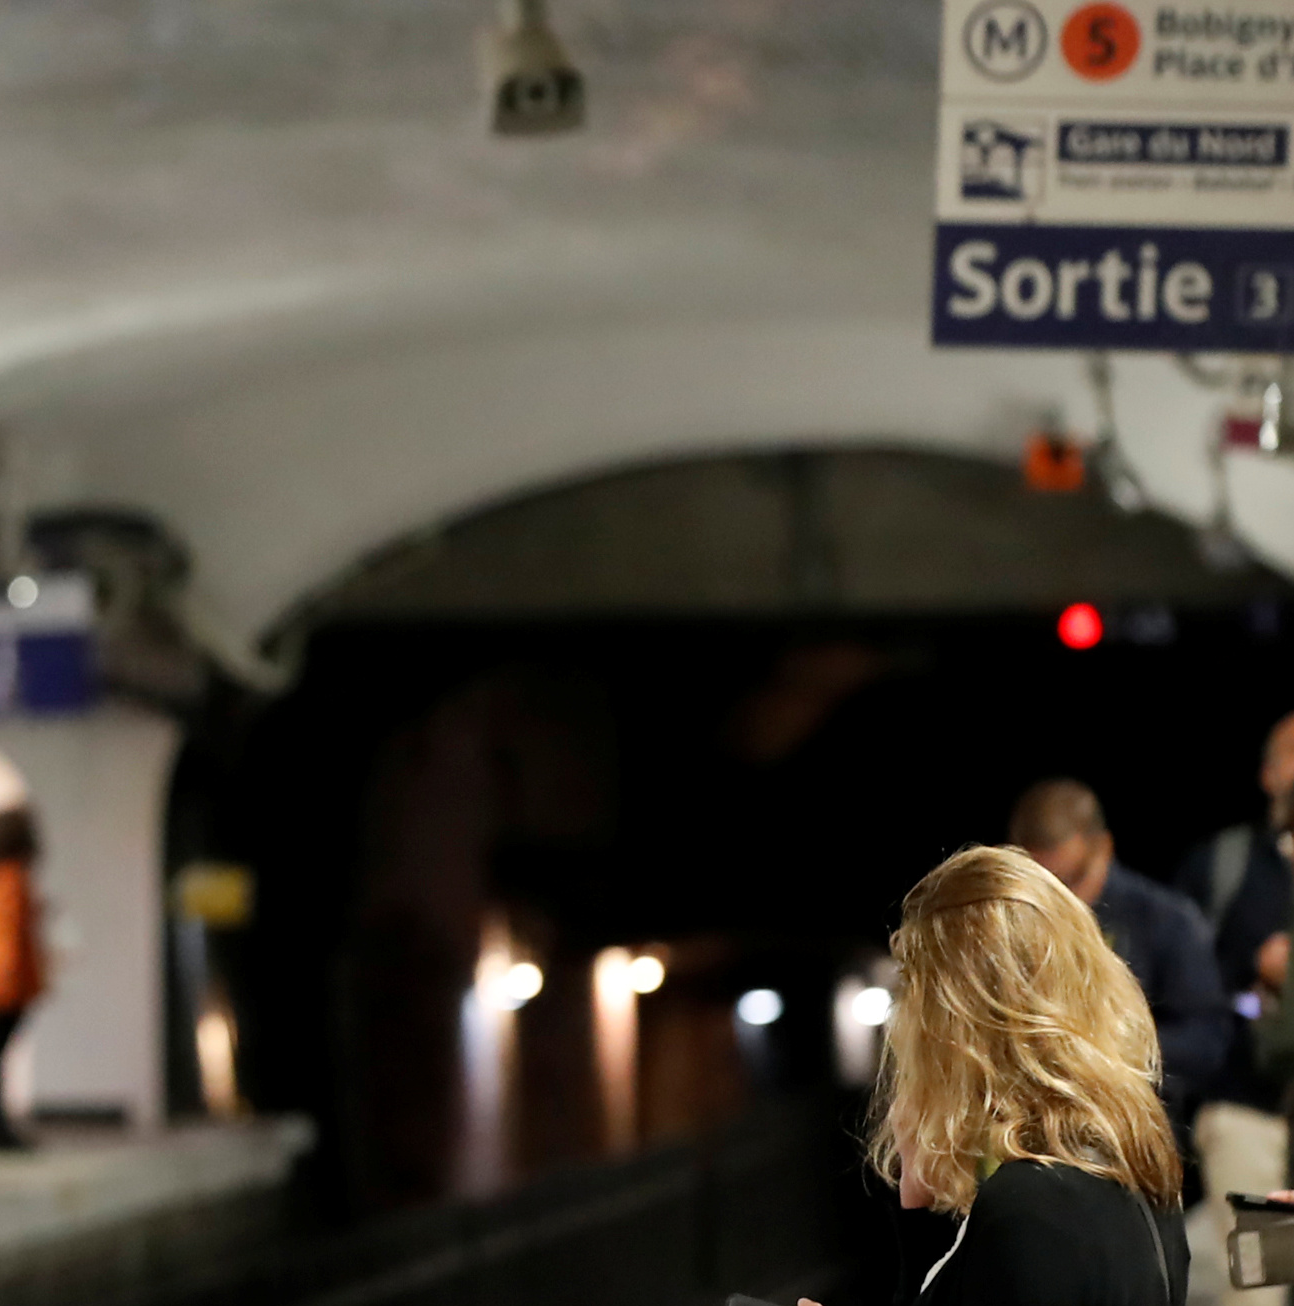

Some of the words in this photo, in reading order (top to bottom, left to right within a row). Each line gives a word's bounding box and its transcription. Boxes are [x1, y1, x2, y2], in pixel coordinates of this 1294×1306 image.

[1087, 18, 1117, 67] 5
[1154, 48, 1245, 77] Place
[1066, 125, 1142, 159] Gare
[1147, 126, 1191, 161] du
[1197, 127, 1277, 162] Nord
[945, 239, 1214, 324] Sortie
[1249, 269, 1279, 320] 3
